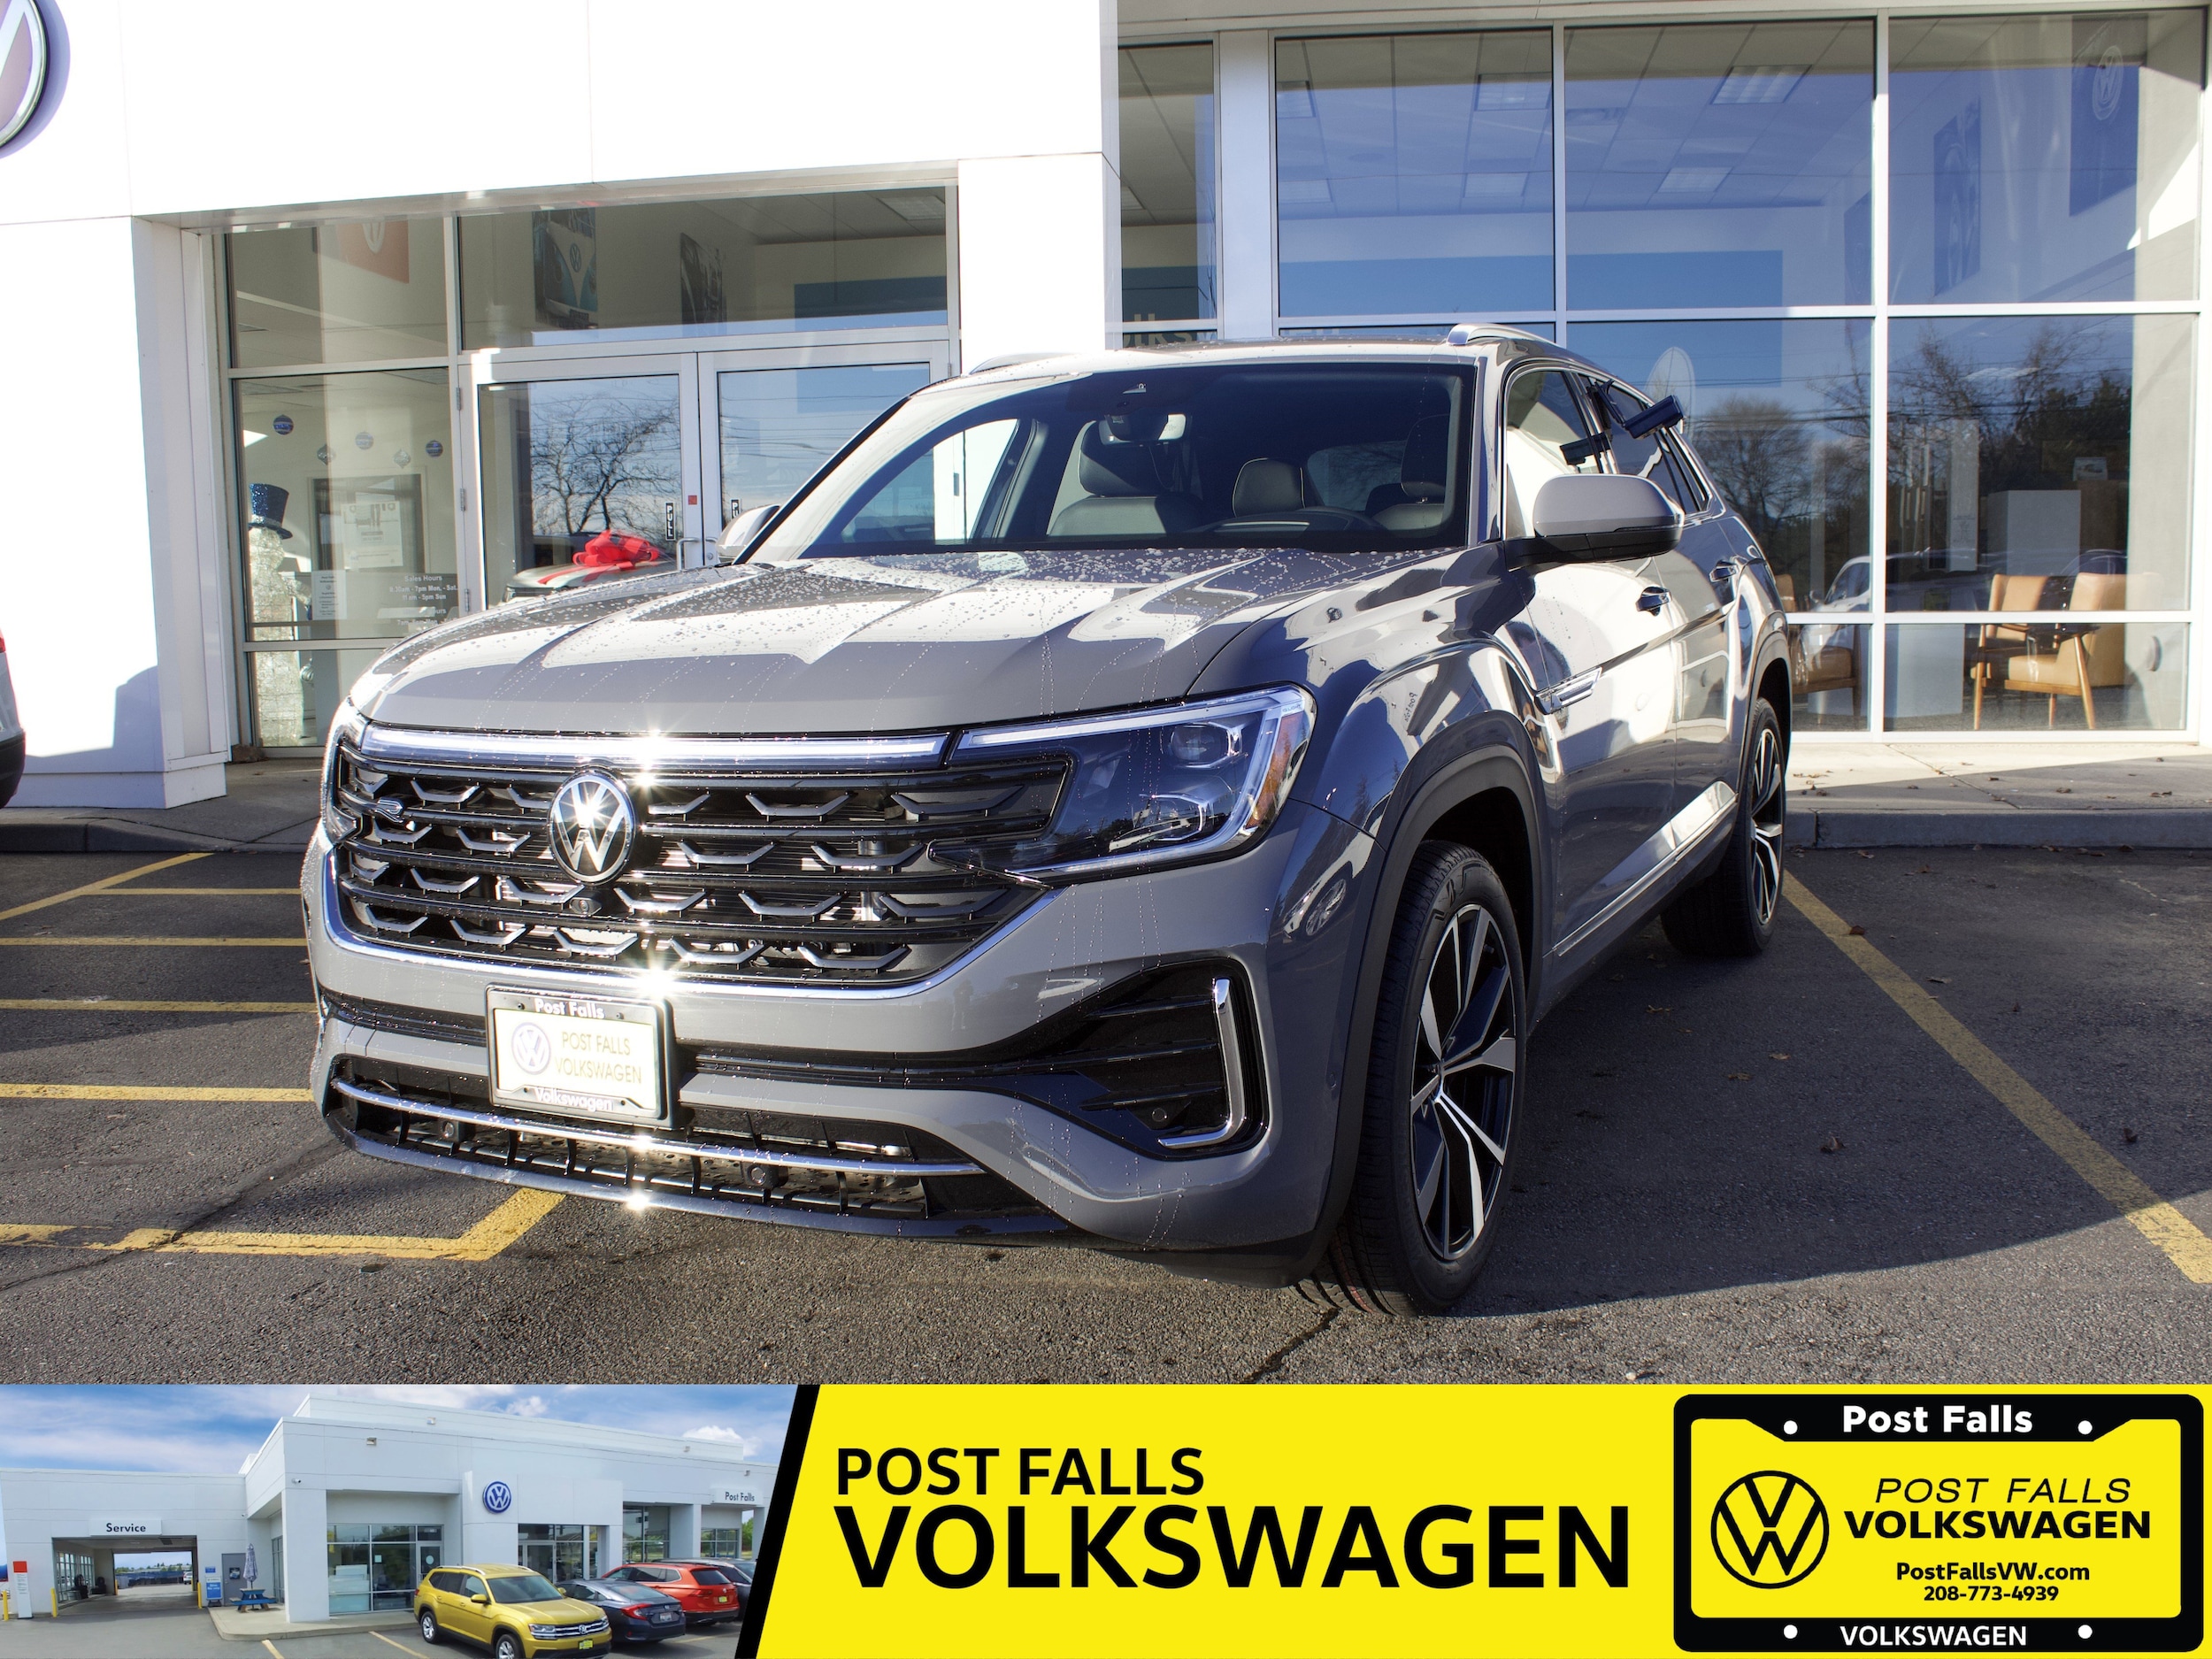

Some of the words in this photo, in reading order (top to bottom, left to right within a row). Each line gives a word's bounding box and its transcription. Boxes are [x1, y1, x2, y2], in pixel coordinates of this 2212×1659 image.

[534, 998, 565, 1015] Post
[569, 1002, 606, 1019] Falls
[562, 1032, 592, 1052] POST
[596, 1035, 631, 1056] FALLS
[554, 1056, 642, 1084] VOLKSWAGEN
[534, 1087, 614, 1111] Volkswagen
